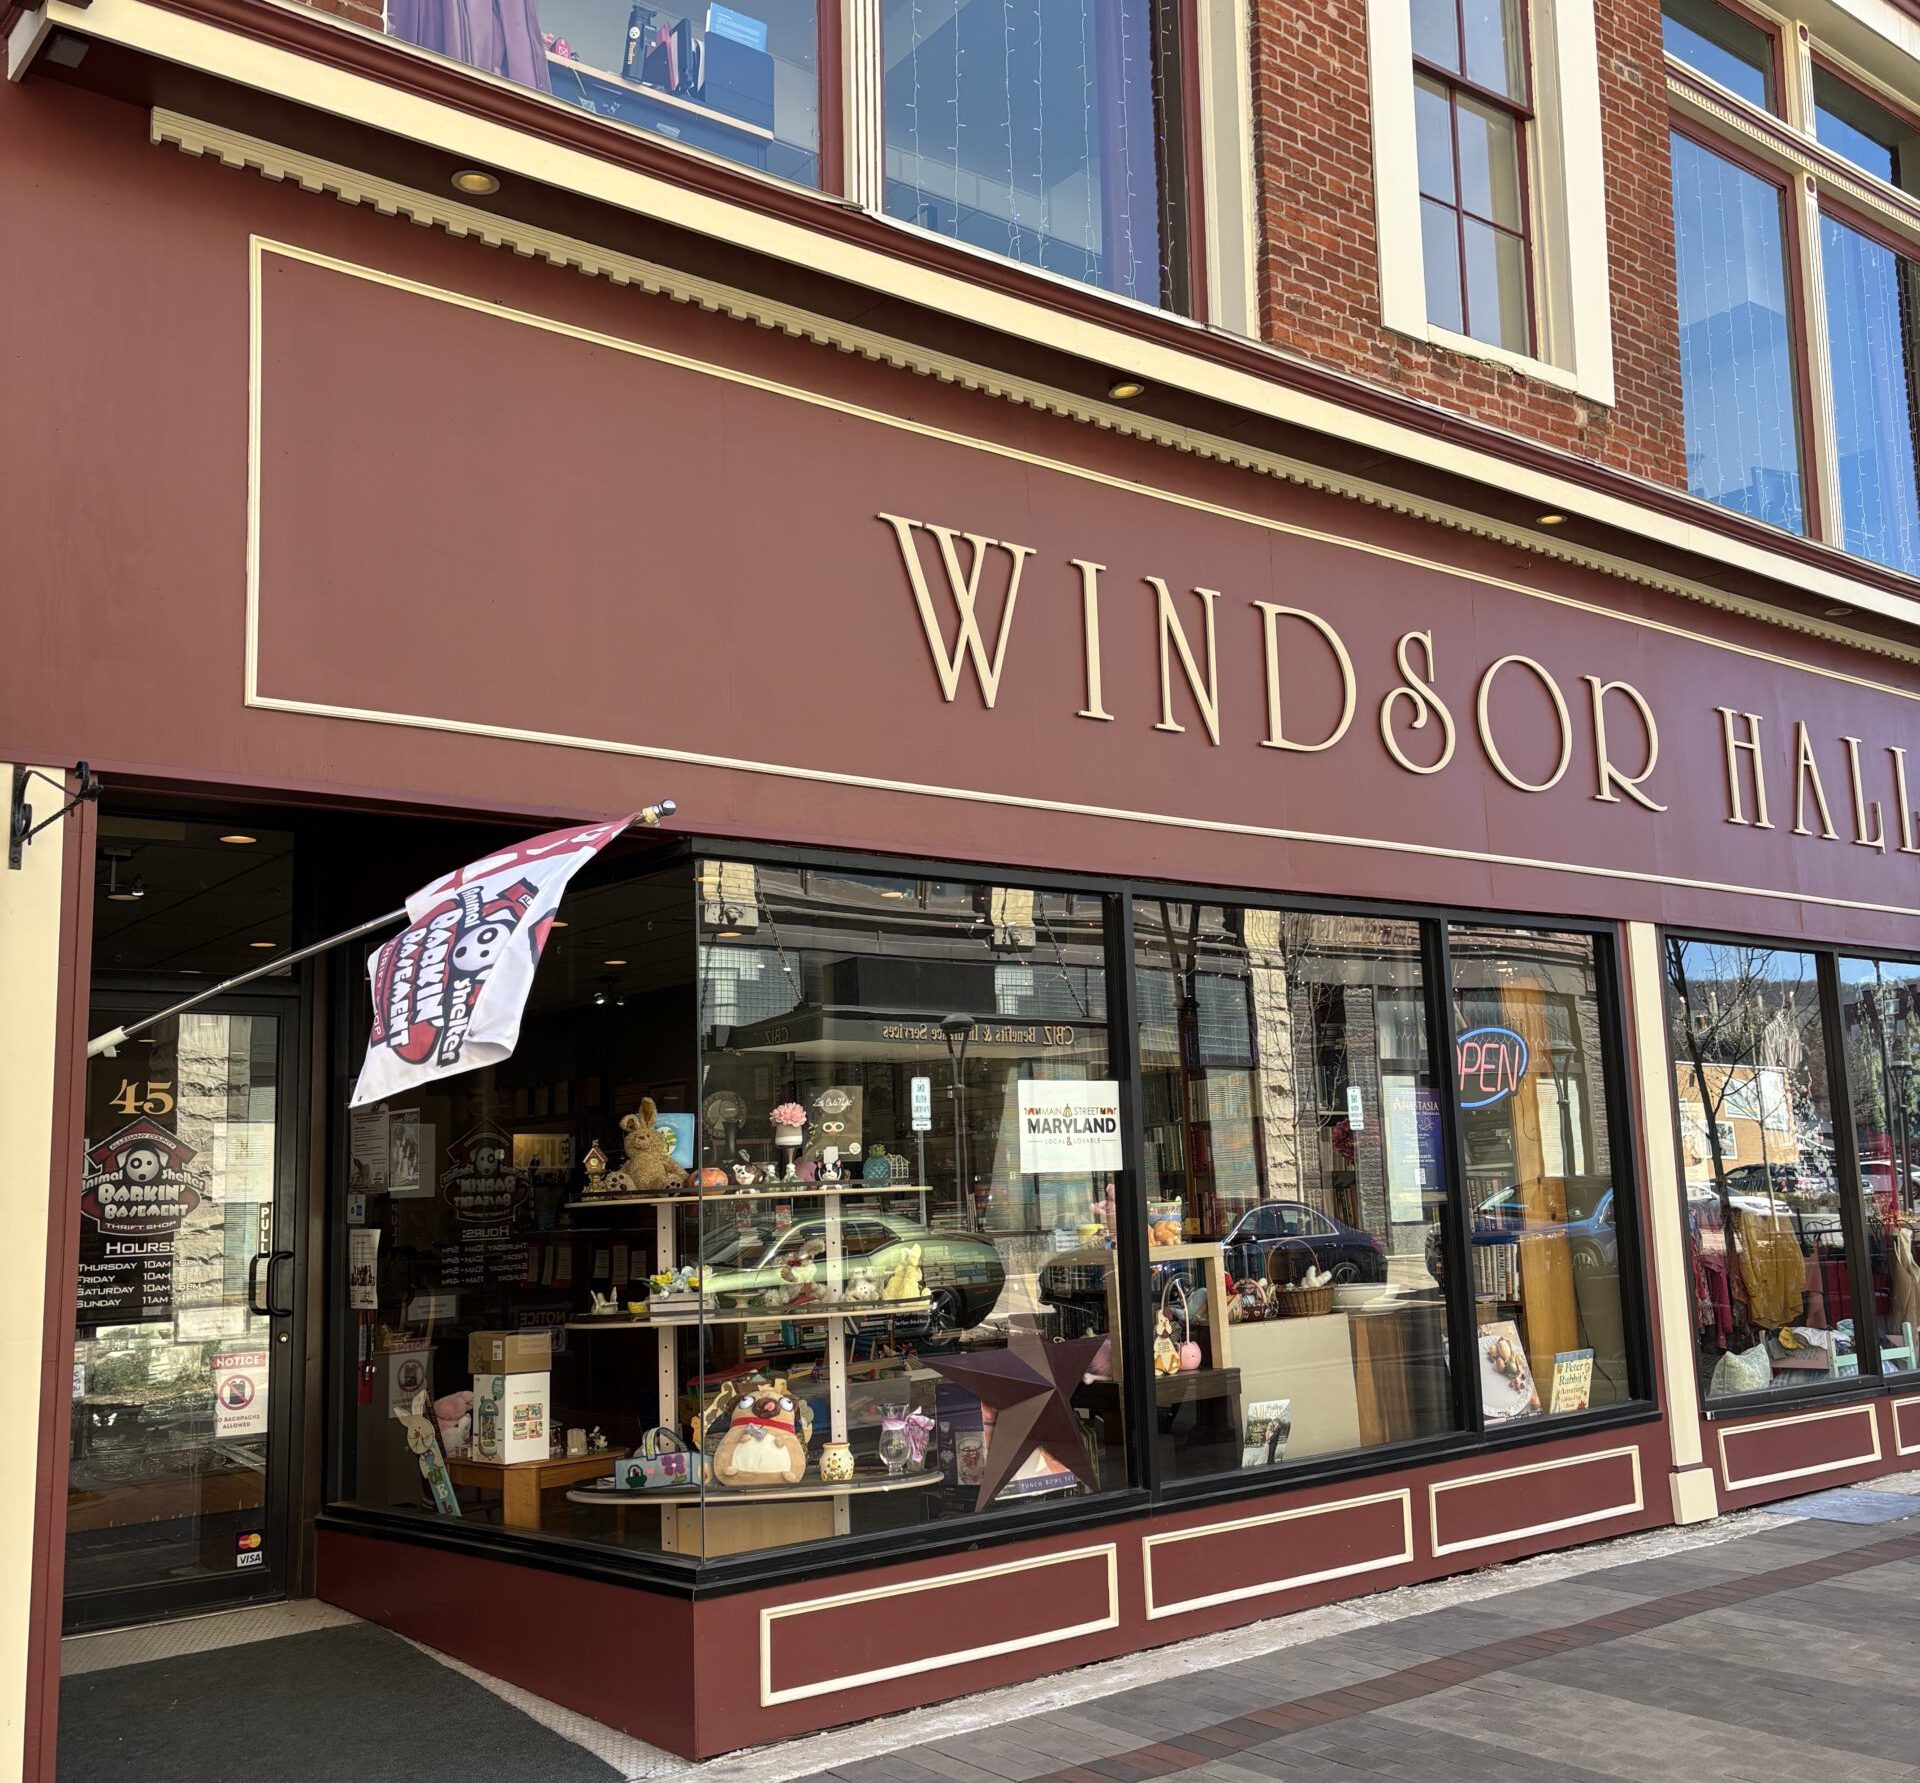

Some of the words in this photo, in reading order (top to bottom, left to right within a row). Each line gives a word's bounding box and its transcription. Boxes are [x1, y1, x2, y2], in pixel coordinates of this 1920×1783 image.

[876, 511, 1668, 812] WINDSOR
[1716, 706, 1920, 855] HALL
[461, 887, 484, 927] Animal
[416, 907, 463, 1028] BARKIN'
[389, 927, 427, 1048] BASEMENT
[442, 977, 473, 1062] Shelter
[1456, 1043, 1519, 1092] PEN
[108, 1078, 175, 1115] 45
[1041, 1107, 1062, 1115] MAIN
[1073, 1106, 1100, 1116] STREET
[1027, 1117, 1116, 1134] MARYLAND
[1066, 1136, 1073, 1146] &
[162, 1168, 205, 1191] Shelter
[98, 1183, 186, 1204] BARKIN'
[104, 1204, 189, 1219] BASEMENT
[105, 1222, 144, 1230] THRIFT
[145, 1220, 177, 1229] SHOP
[260, 1207, 270, 1254] PULL
[105, 1241, 176, 1255] HOURS:
[77, 1262, 138, 1272] THURSDAY
[143, 1260, 171, 1269] 10AM
[77, 1275, 116, 1284] FRIDAY
[143, 1272, 171, 1280] 10AM
[77, 1286, 135, 1296] SATURDAY
[143, 1284, 171, 1293] 10AM
[76, 1299, 121, 1309] SUNDAY
[142, 1296, 169, 1304] 11AM
[216, 1355, 261, 1367] NOTICE
[1565, 1361, 1584, 1373] Peter
[1559, 1372, 1588, 1385] Rabbit's
[222, 1422, 251, 1430] ALLOWED
[1020, 1481, 1043, 1490] PUNCH
[1045, 1478, 1062, 1486] BOWL
[240, 1553, 261, 1565] VISA
